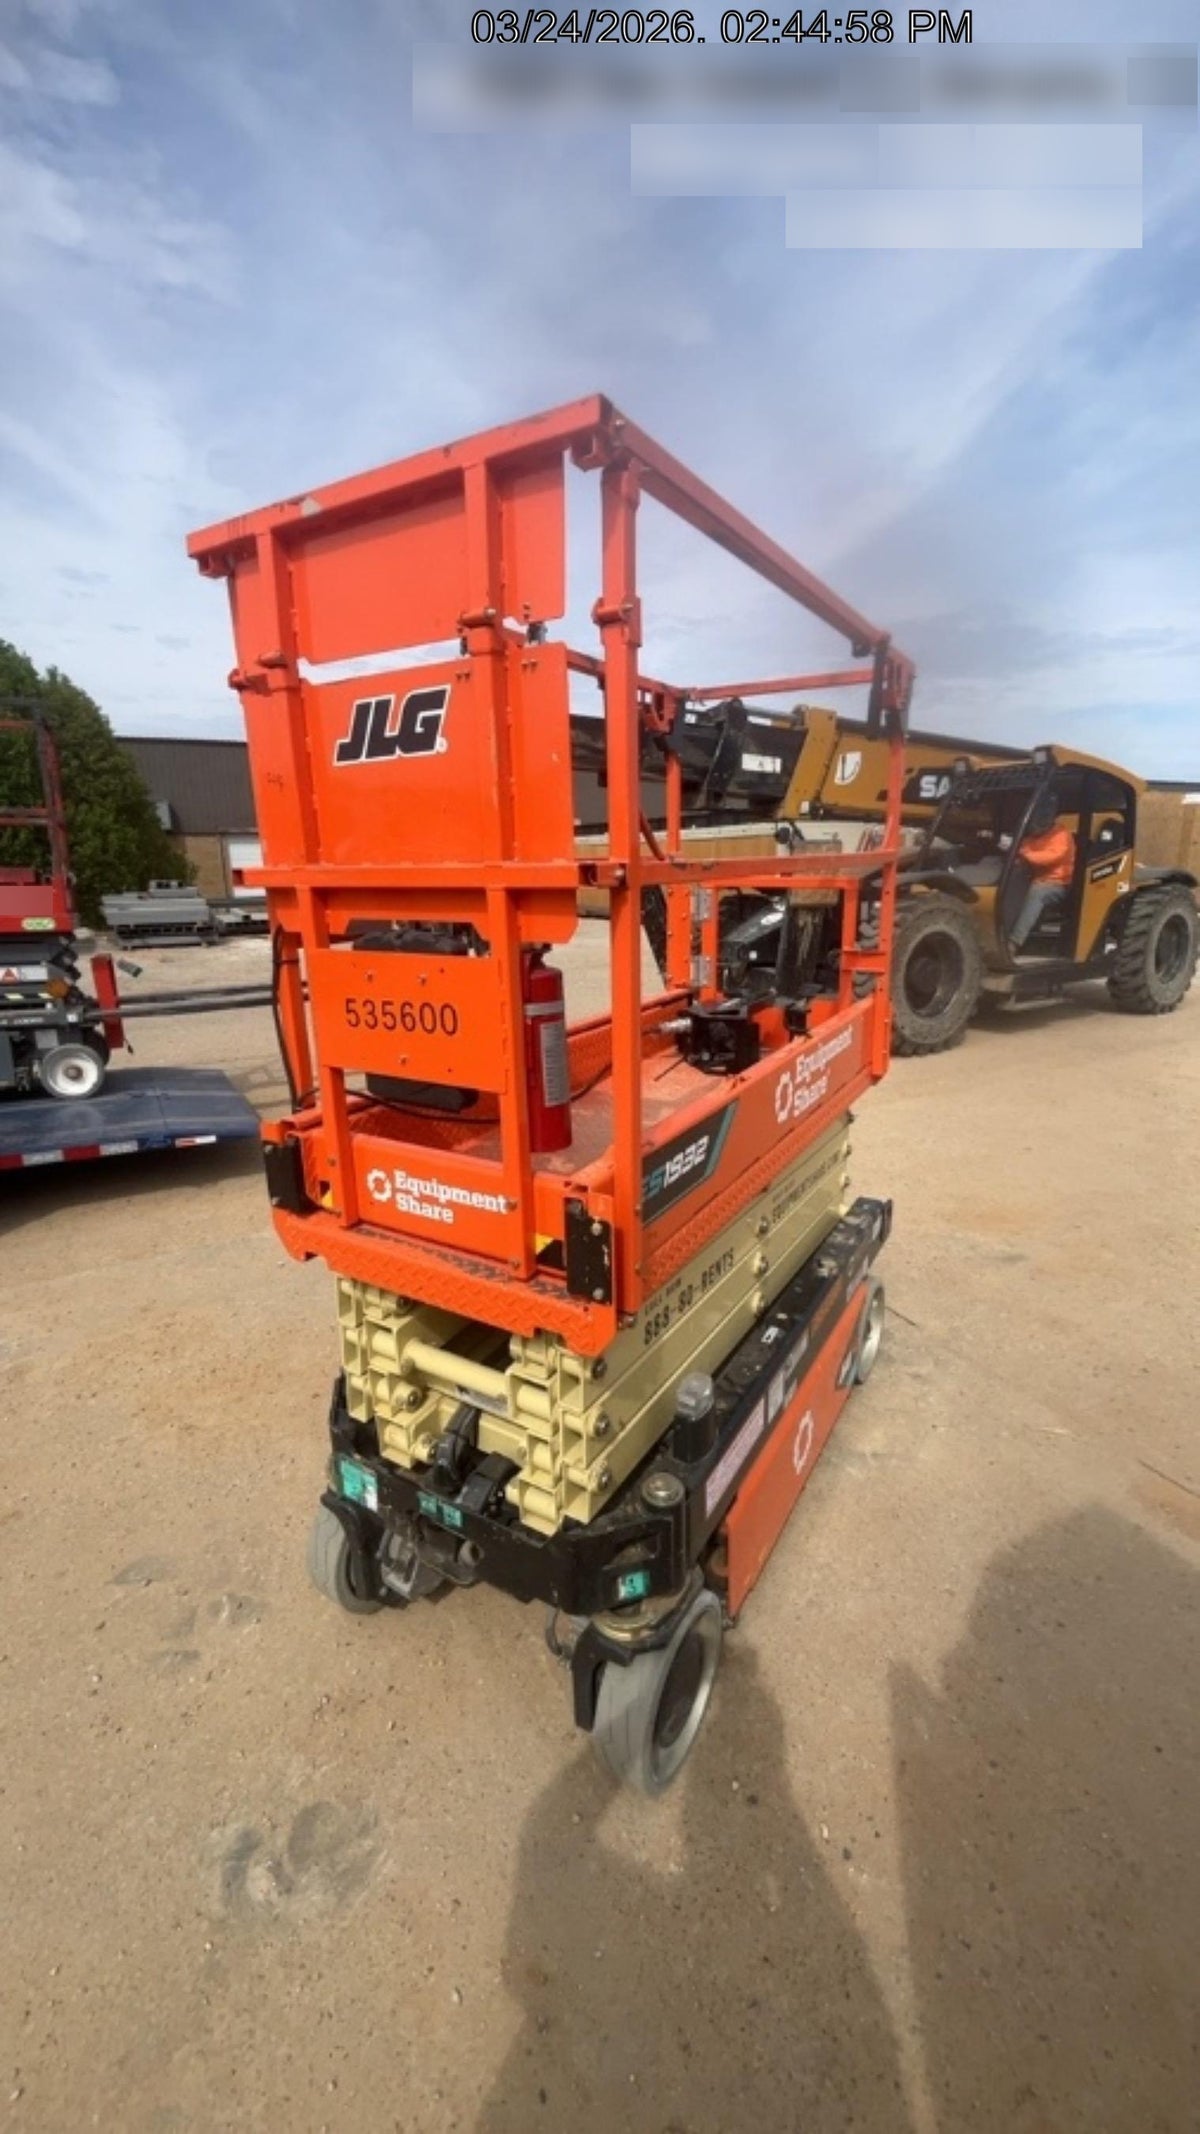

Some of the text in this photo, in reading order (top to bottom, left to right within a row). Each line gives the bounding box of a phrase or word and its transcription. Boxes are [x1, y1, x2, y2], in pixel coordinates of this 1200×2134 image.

[333, 685, 449, 766] JLG
[345, 998, 458, 1036] 535600
[795, 1024, 853, 1084] Equipment
[793, 1074, 829, 1117] Share
[394, 1170, 509, 1214] Equipment
[395, 1192, 455, 1224] Share
